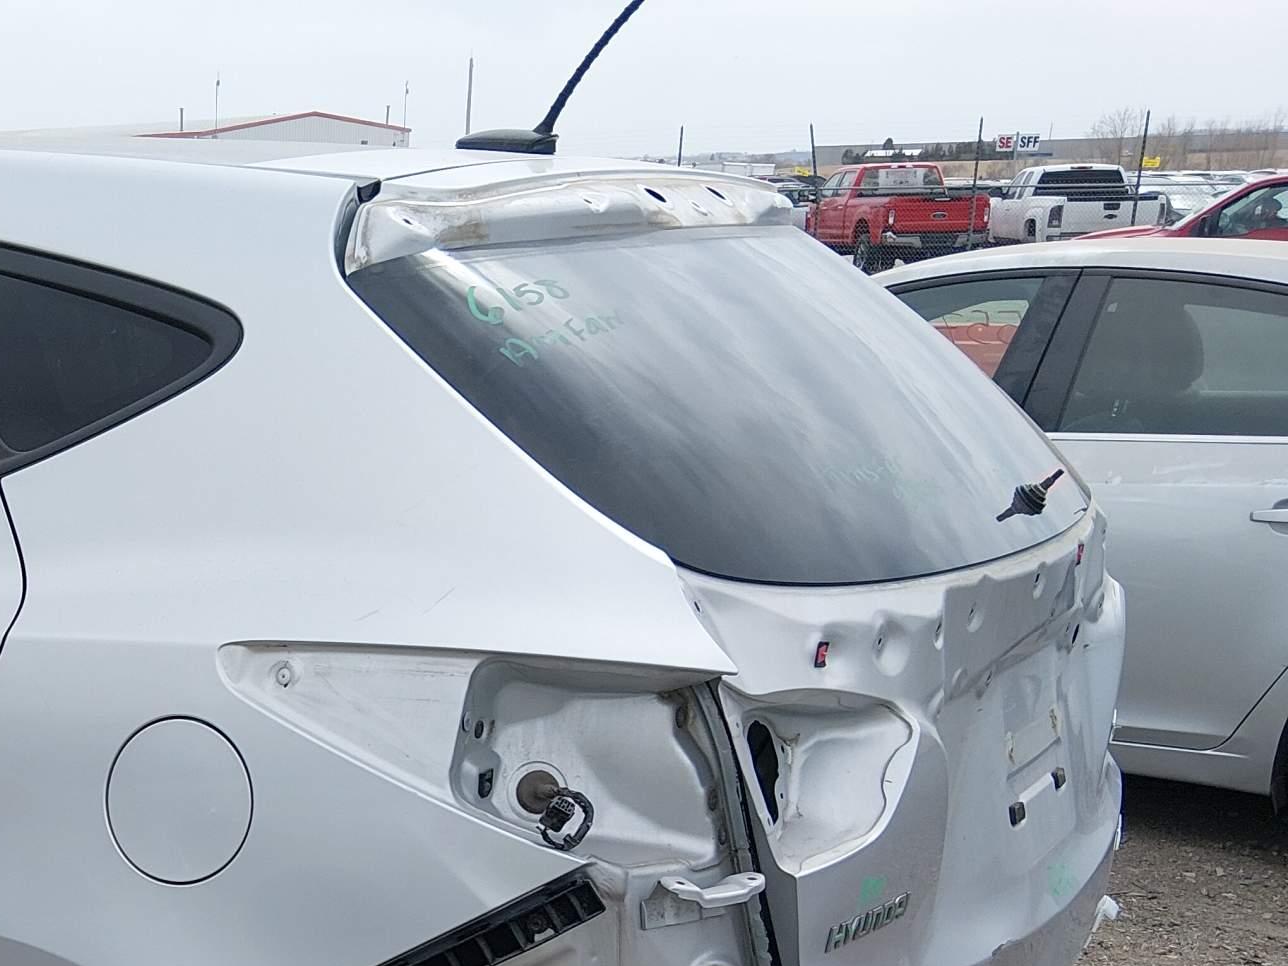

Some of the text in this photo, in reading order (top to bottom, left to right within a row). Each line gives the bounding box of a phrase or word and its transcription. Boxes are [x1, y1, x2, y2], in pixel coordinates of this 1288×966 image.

[998, 136, 1013, 149] SE
[1019, 135, 1040, 149] SFF
[467, 278, 570, 325] 6158
